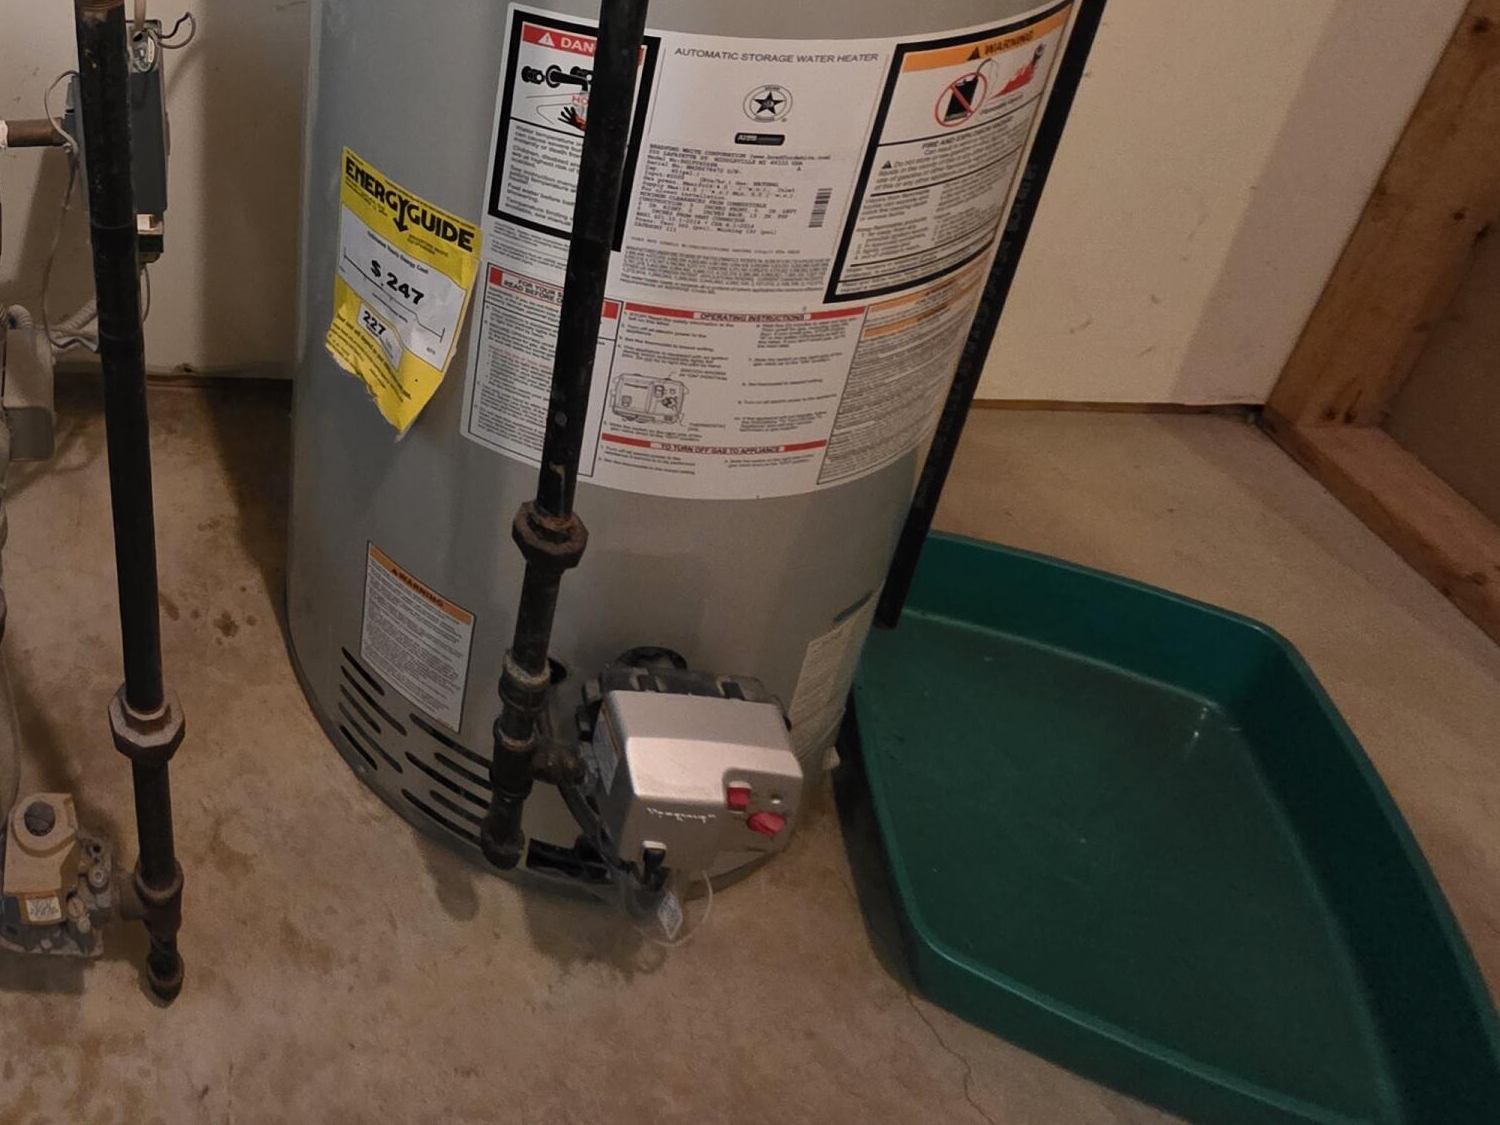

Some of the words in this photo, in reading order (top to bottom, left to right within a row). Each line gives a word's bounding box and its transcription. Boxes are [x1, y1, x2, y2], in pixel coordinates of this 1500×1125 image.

[561, 37, 595, 53] DAN
[674, 47, 739, 61] AUTOMATIC
[740, 52, 795, 63] STORAGE
[797, 54, 835, 63] WATER
[836, 53, 880, 63] HEATER
[984, 30, 1035, 55] WARNING
[345, 156, 475, 253] ENERGYGUIDE
[371, 260, 382, 278] $
[387, 272, 424, 305] 247
[362, 310, 387, 335] 227
[700, 312, 747, 322] OPERATING
[749, 313, 806, 323] INSTRUCTIONS
[673, 444, 693, 453] TURN
[398, 572, 444, 608] WARNING
